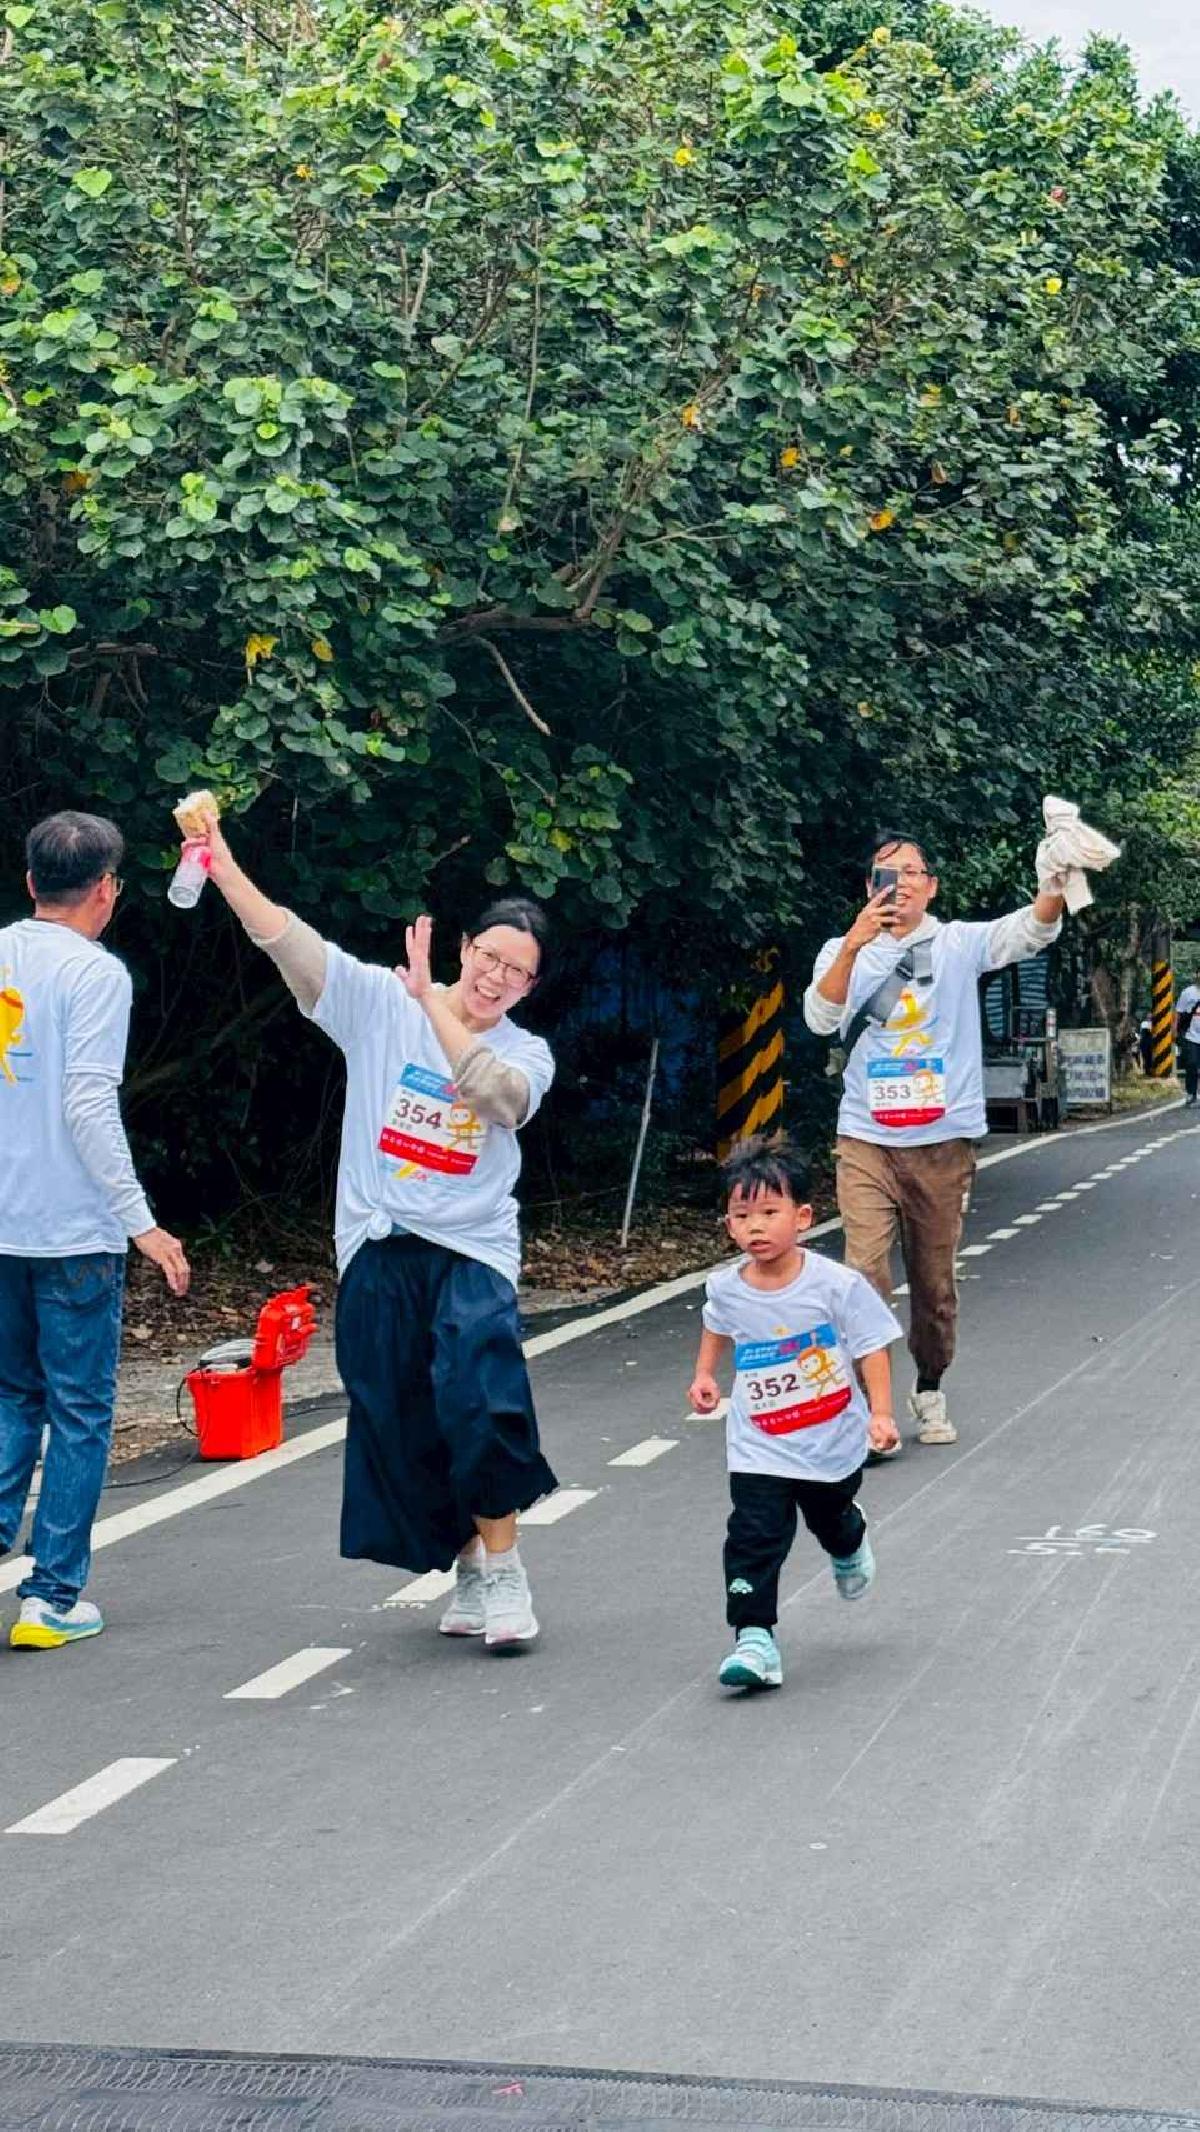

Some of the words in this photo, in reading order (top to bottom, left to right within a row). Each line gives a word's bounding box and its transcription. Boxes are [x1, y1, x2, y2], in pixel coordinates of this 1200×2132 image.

[873, 1085, 911, 1100] 353
[395, 1098, 443, 1130] 354
[746, 1373, 801, 1401] 352
